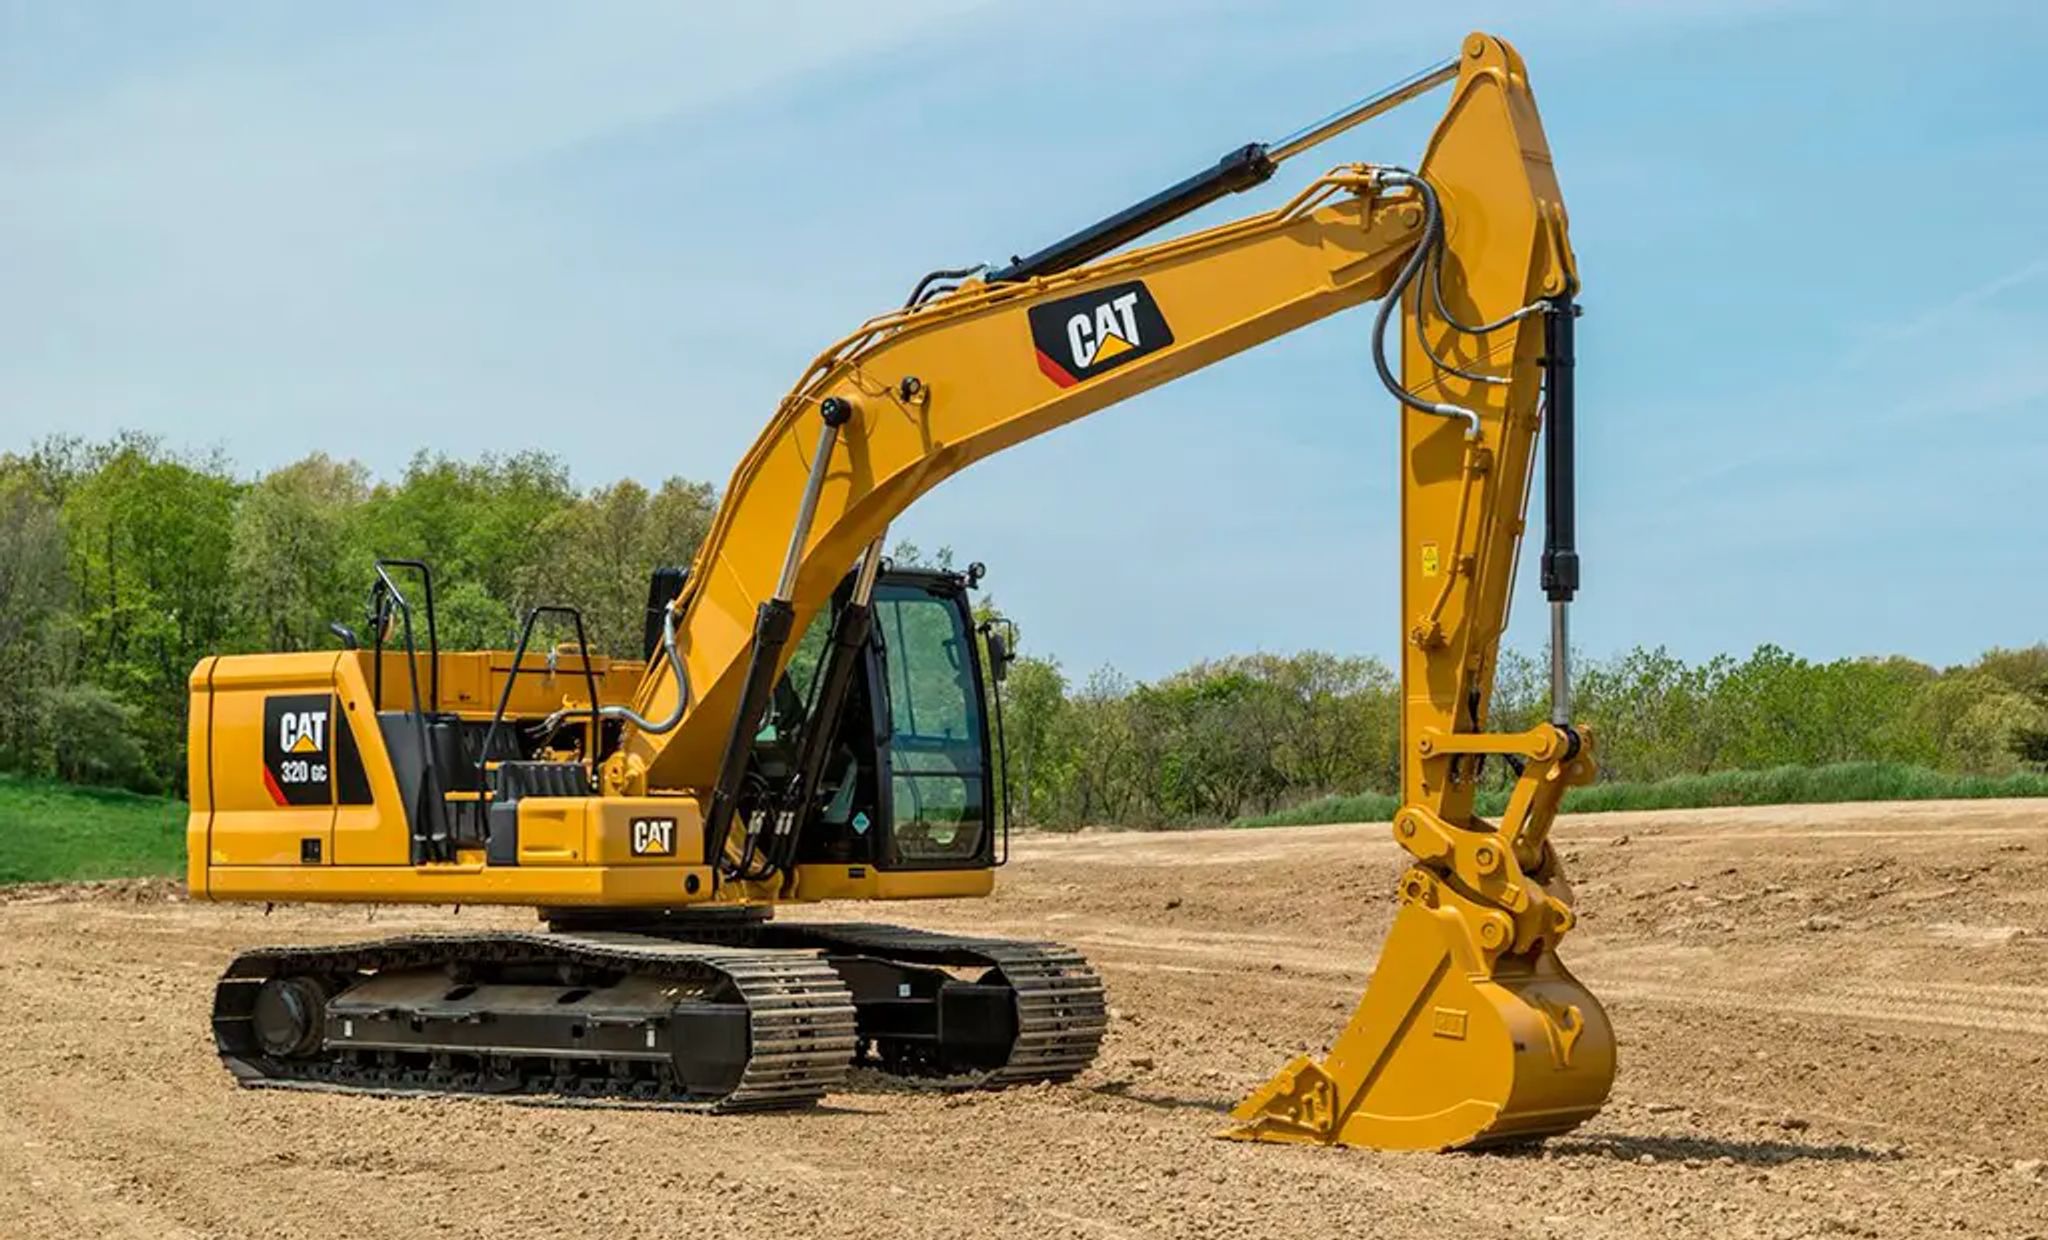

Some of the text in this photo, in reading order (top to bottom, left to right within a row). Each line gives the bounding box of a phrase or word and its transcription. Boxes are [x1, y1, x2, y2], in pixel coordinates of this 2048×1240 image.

[1067, 292, 1140, 368] CAT
[281, 712, 327, 753] CAT
[281, 761, 327, 783] 320 GC
[634, 821, 673, 853] CAT
